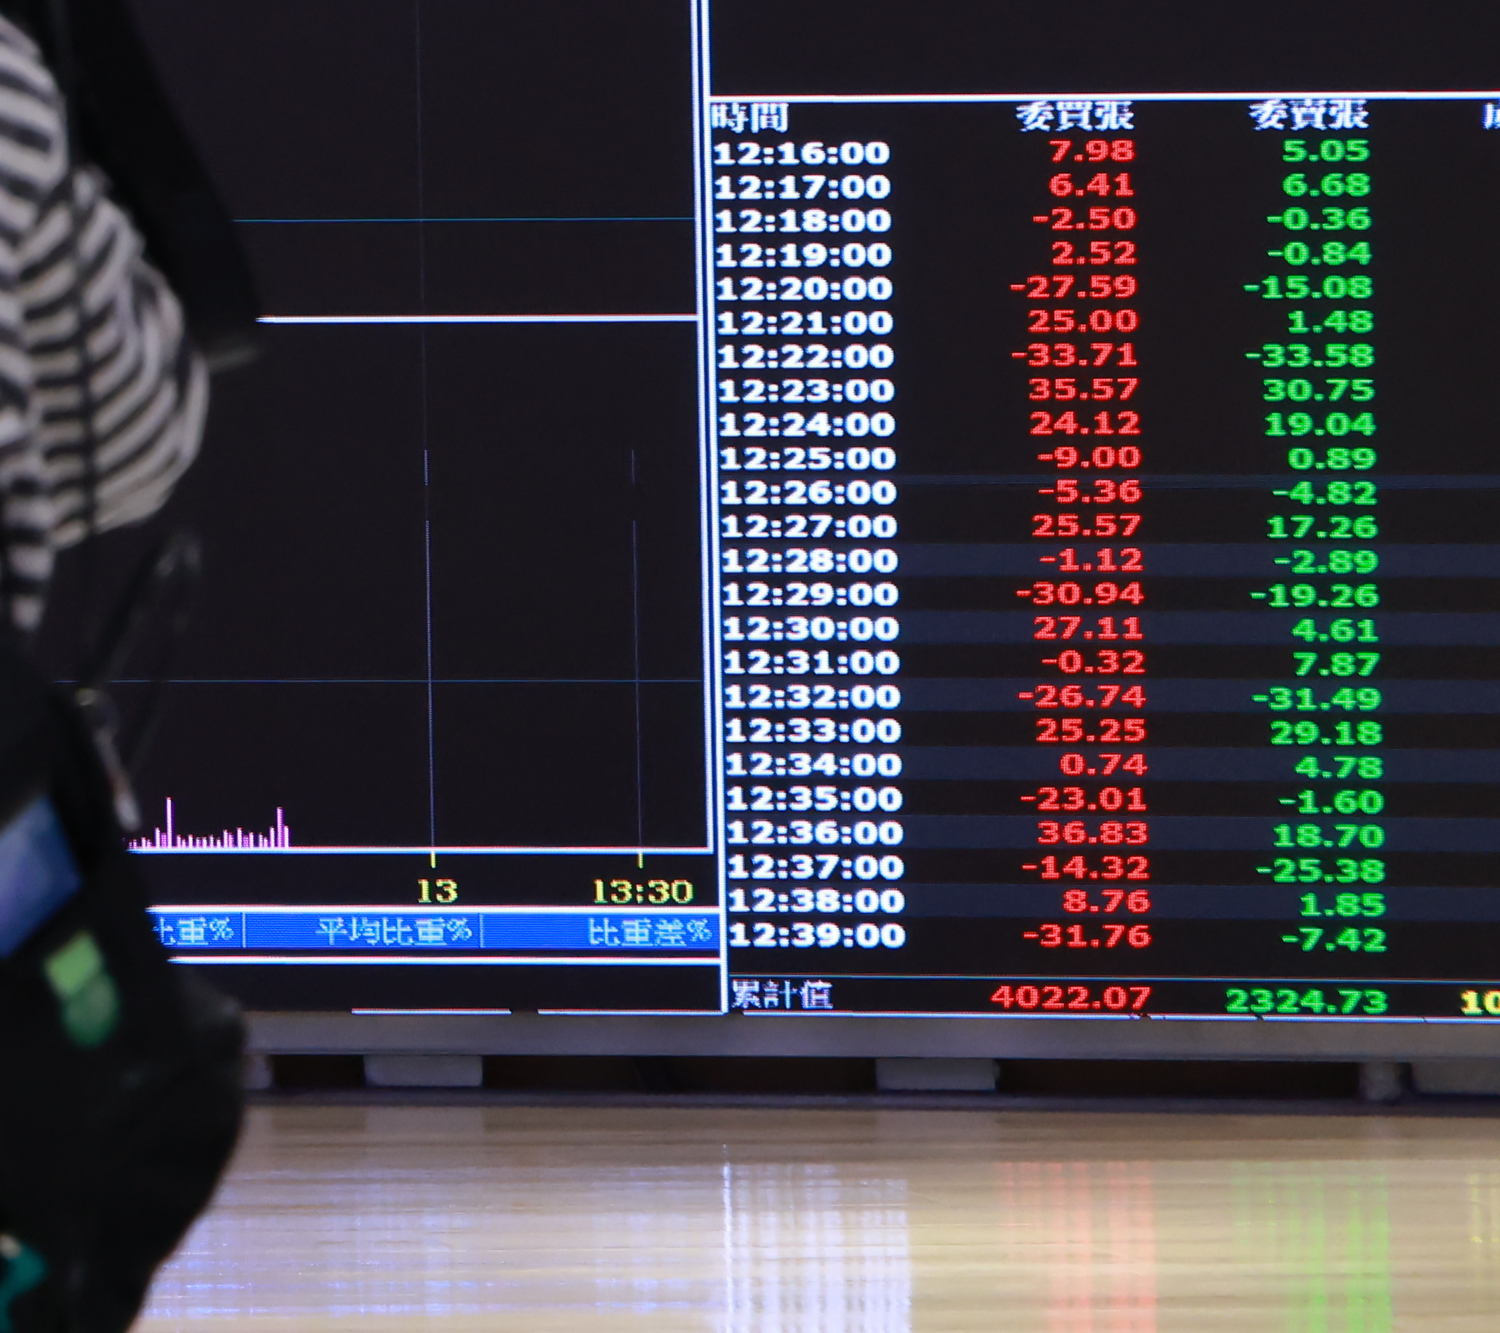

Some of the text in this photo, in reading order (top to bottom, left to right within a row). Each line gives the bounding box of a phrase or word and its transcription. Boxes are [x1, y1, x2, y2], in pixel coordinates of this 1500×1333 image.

[711, 103, 789, 133] 時間
[1016, 101, 1135, 131] 委買張
[713, 139, 1370, 167] 12:16:00 7.98 5.05
[716, 274, 1373, 303] 12:20:00 -27.59 -15.08
[723, 616, 1379, 642] 12:30:00 27.11 4.61
[420, 881, 457, 901] 13
[595, 881, 692, 902] 13:30
[321, 918, 471, 943] 平均比重%
[591, 920, 707, 943] 比重差%
[728, 922, 1387, 952] 12:39:00 -31.76 -7.42
[731, 980, 1388, 1014] 累計值 4022.07 2324.73
